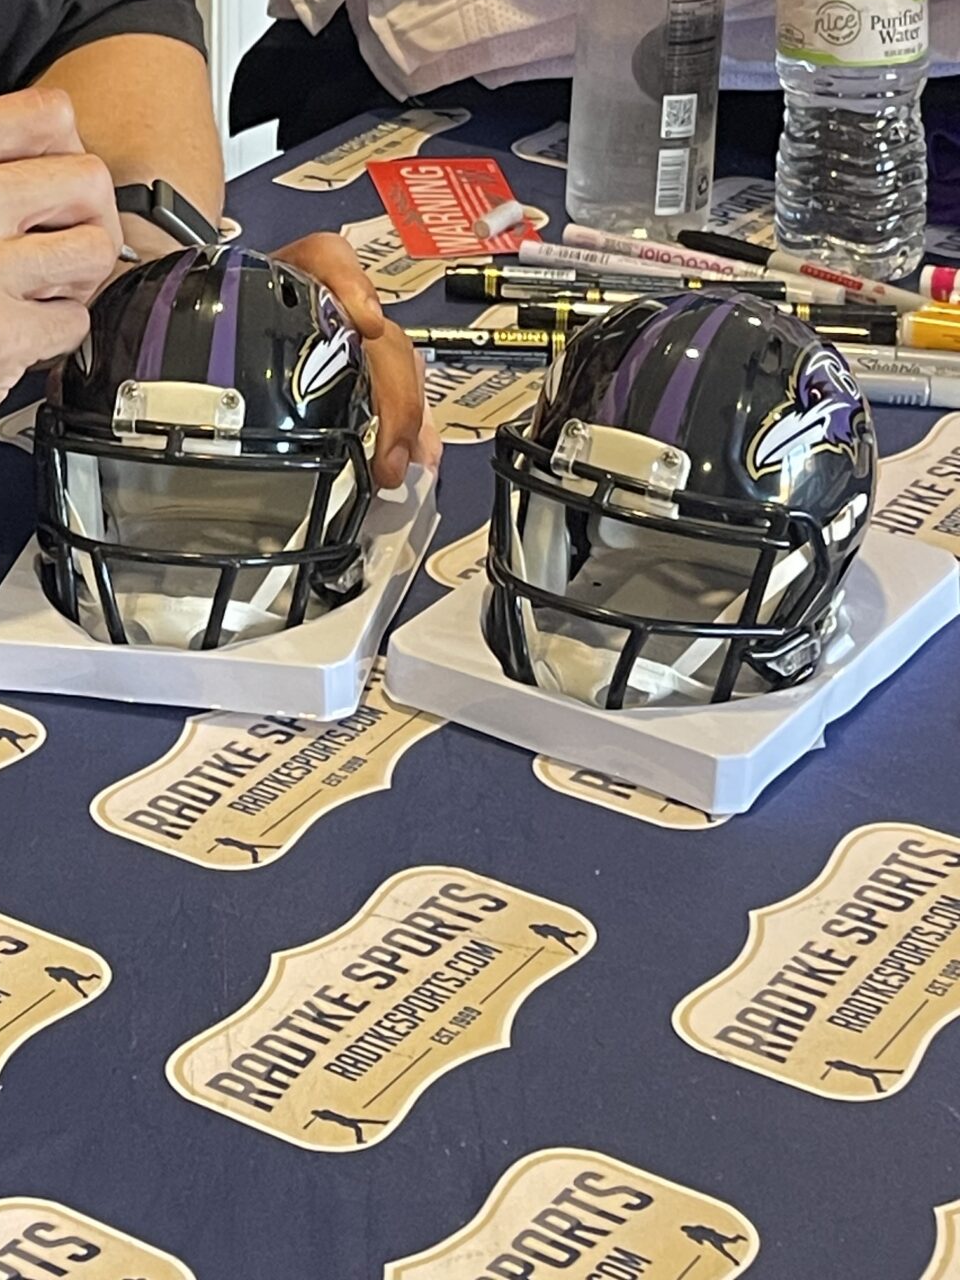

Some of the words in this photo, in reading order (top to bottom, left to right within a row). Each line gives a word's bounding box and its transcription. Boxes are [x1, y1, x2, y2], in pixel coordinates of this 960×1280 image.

[870, 5, 924, 31] Purified
[878, 26, 921, 45] Water
[400, 165, 483, 254] WARNING
[857, 355, 921, 374] Sharpie
[123, 740, 271, 841] RADTKE
[205, 984, 371, 1112] RADTKE
[341, 882, 509, 991] SPORTS
[714, 940, 858, 1064] RADTKE
[821, 839, 960, 946] SPORTS
[323, 939, 503, 1081] RADTKESPORTS.COM
